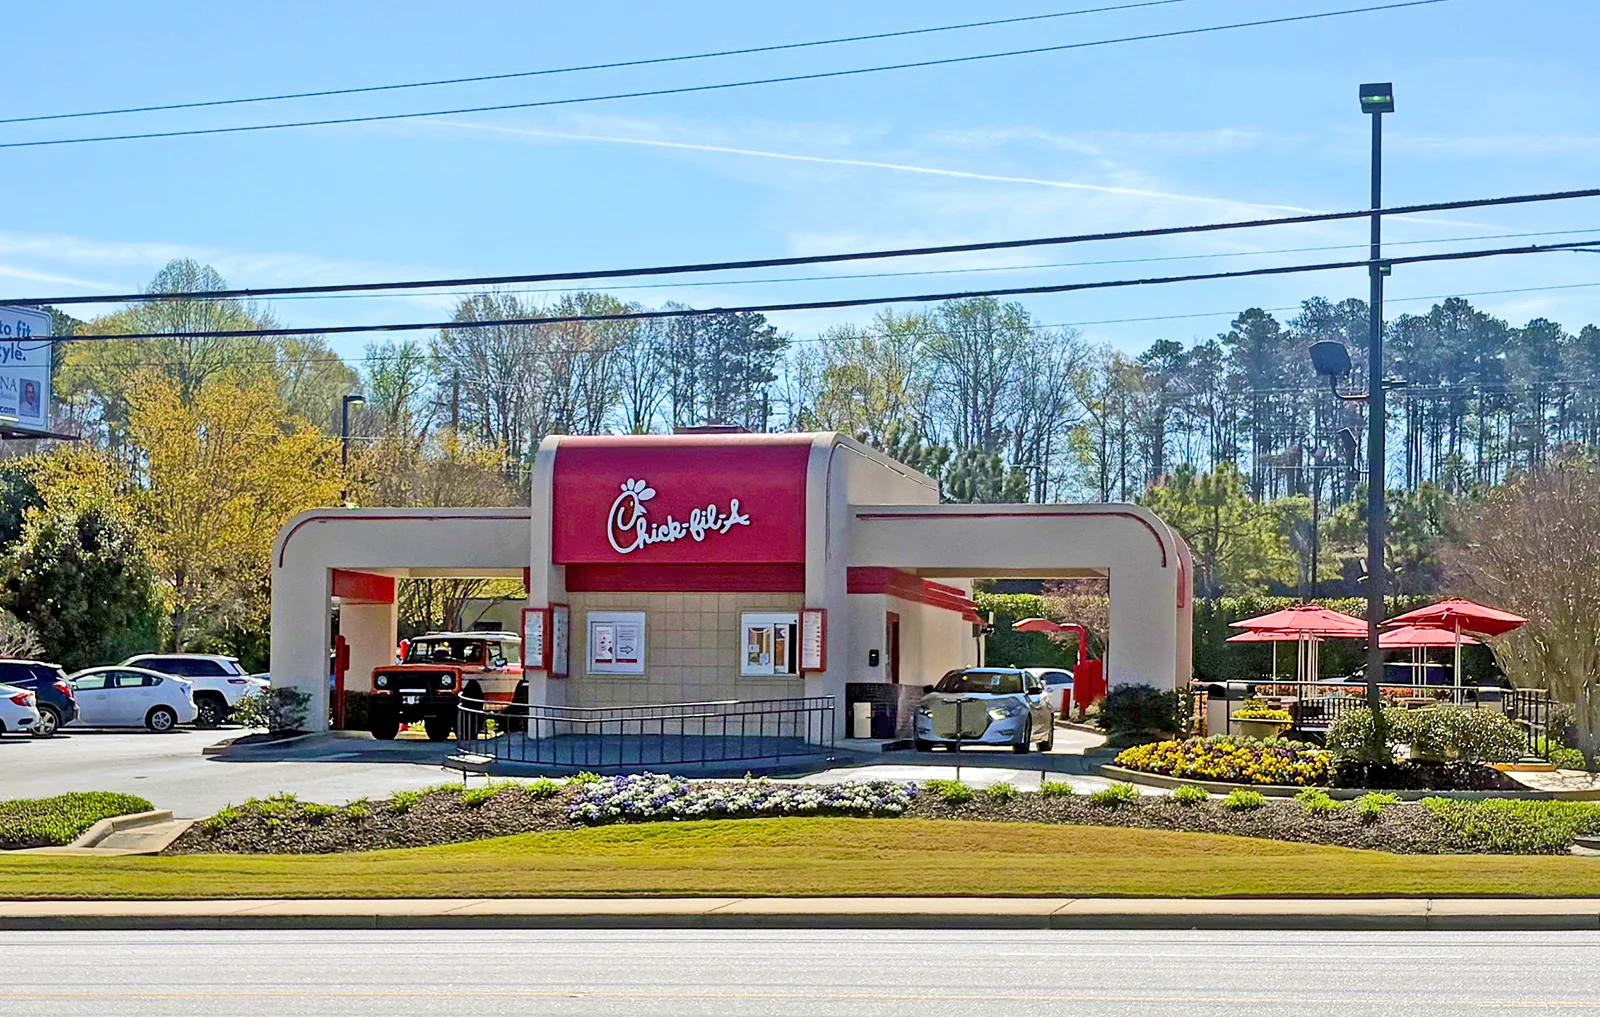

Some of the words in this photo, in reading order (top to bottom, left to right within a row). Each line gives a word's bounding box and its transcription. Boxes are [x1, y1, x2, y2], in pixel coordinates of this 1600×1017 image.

[16, 320, 31, 337] fit
[0, 342, 26, 364] yle.
[607, 478, 750, 554] Chick-fil-A
